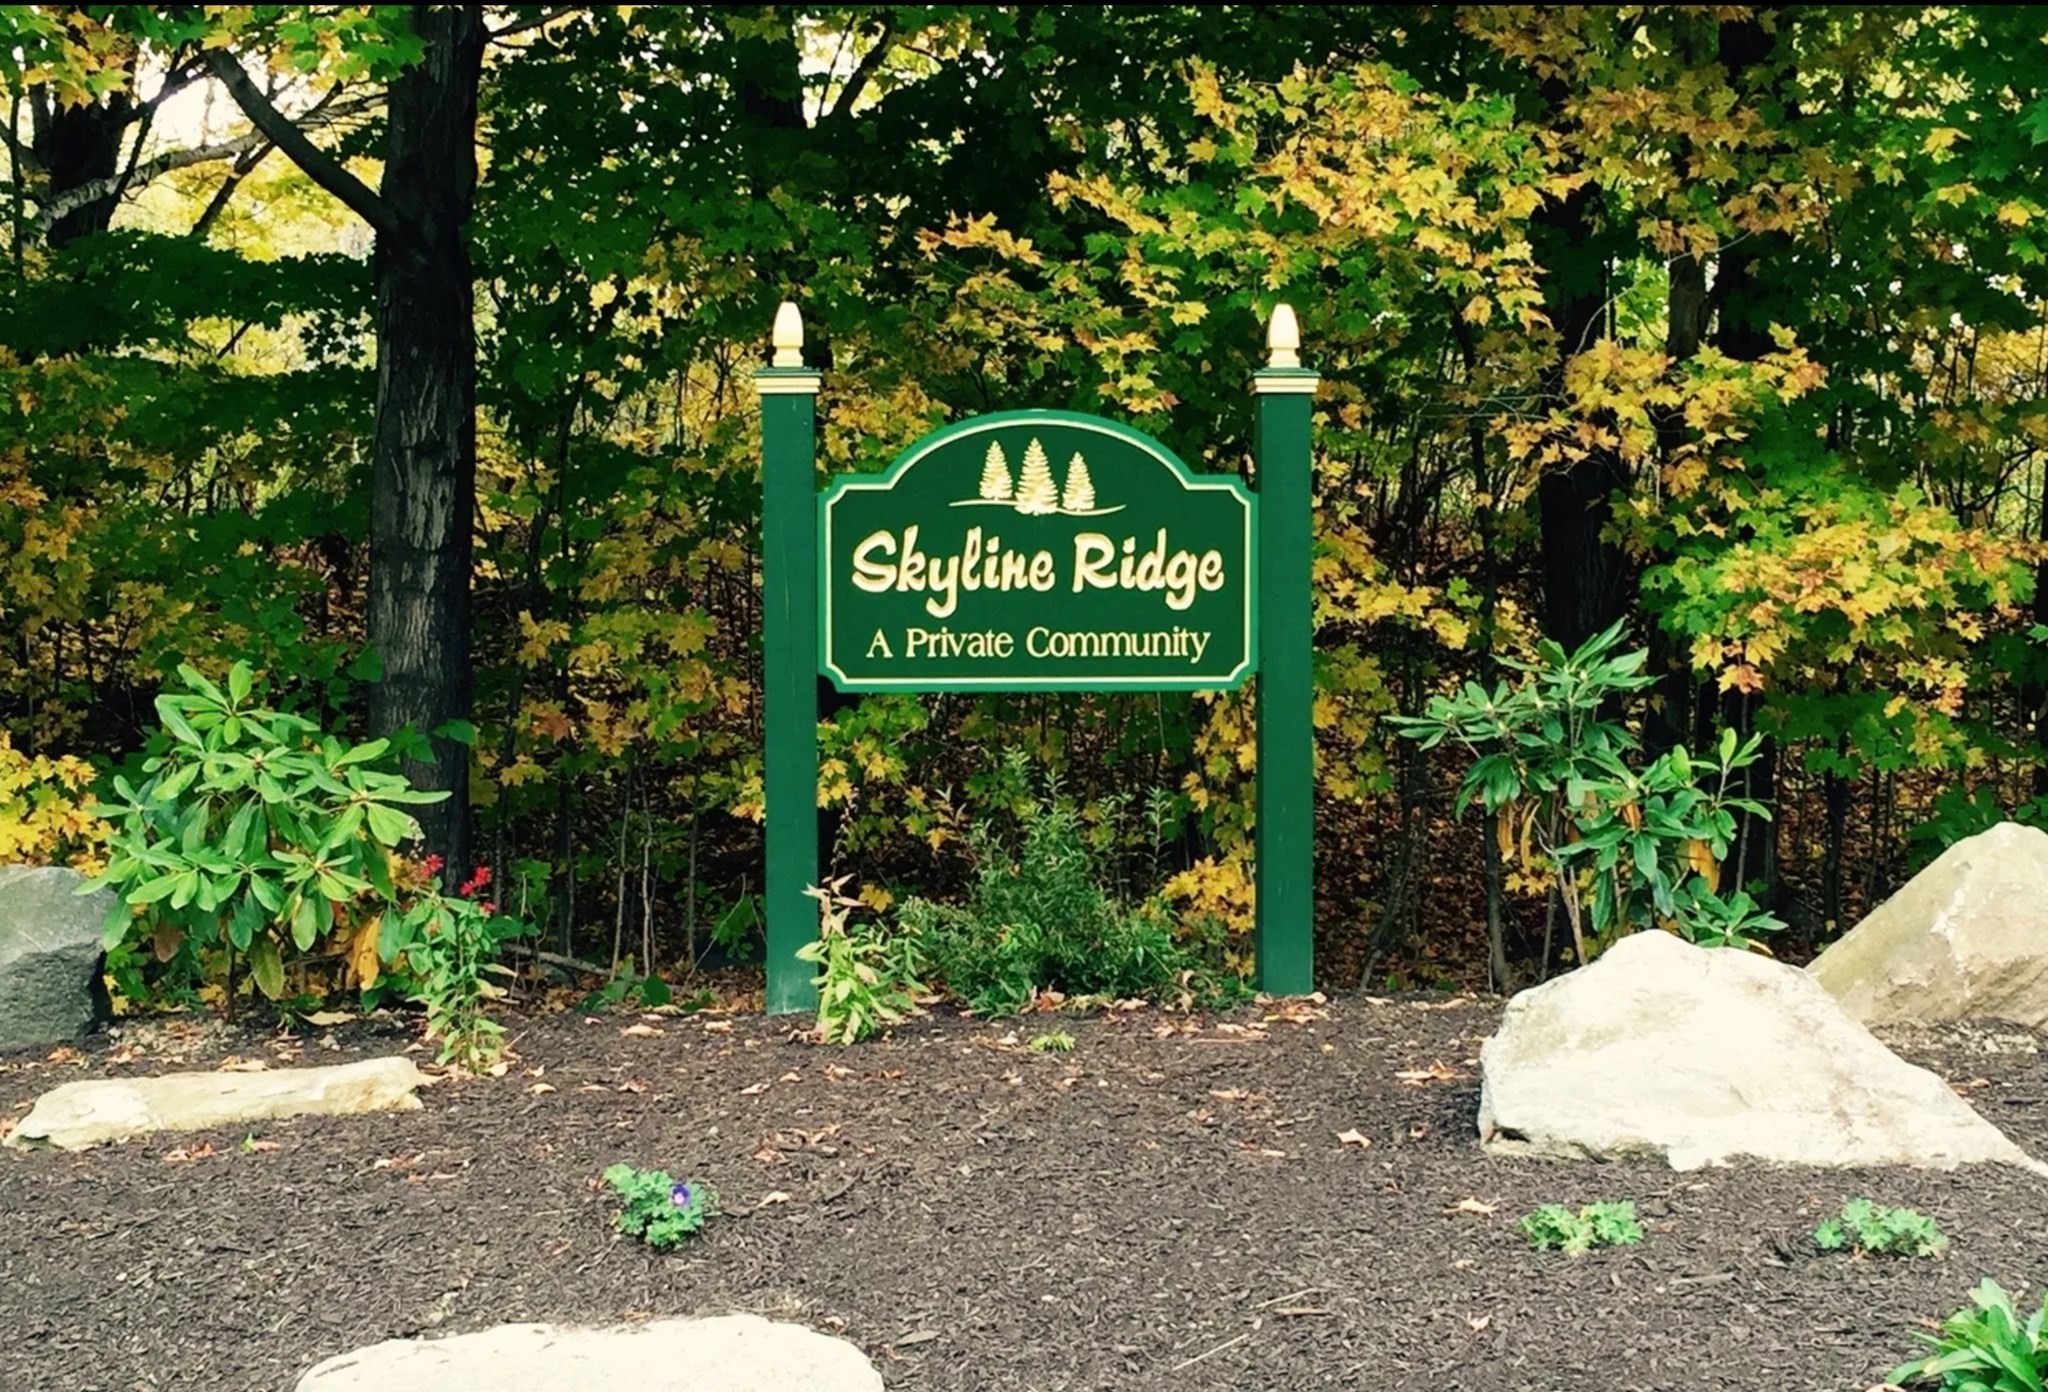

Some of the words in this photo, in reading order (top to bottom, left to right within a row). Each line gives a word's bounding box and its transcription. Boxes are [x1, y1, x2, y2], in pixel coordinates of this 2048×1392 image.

[851, 524, 1056, 619] Skyline
[1071, 527, 1226, 611] Ridge
[865, 628, 894, 659] A
[905, 626, 1015, 659] Private
[1026, 625, 1212, 664] Community
